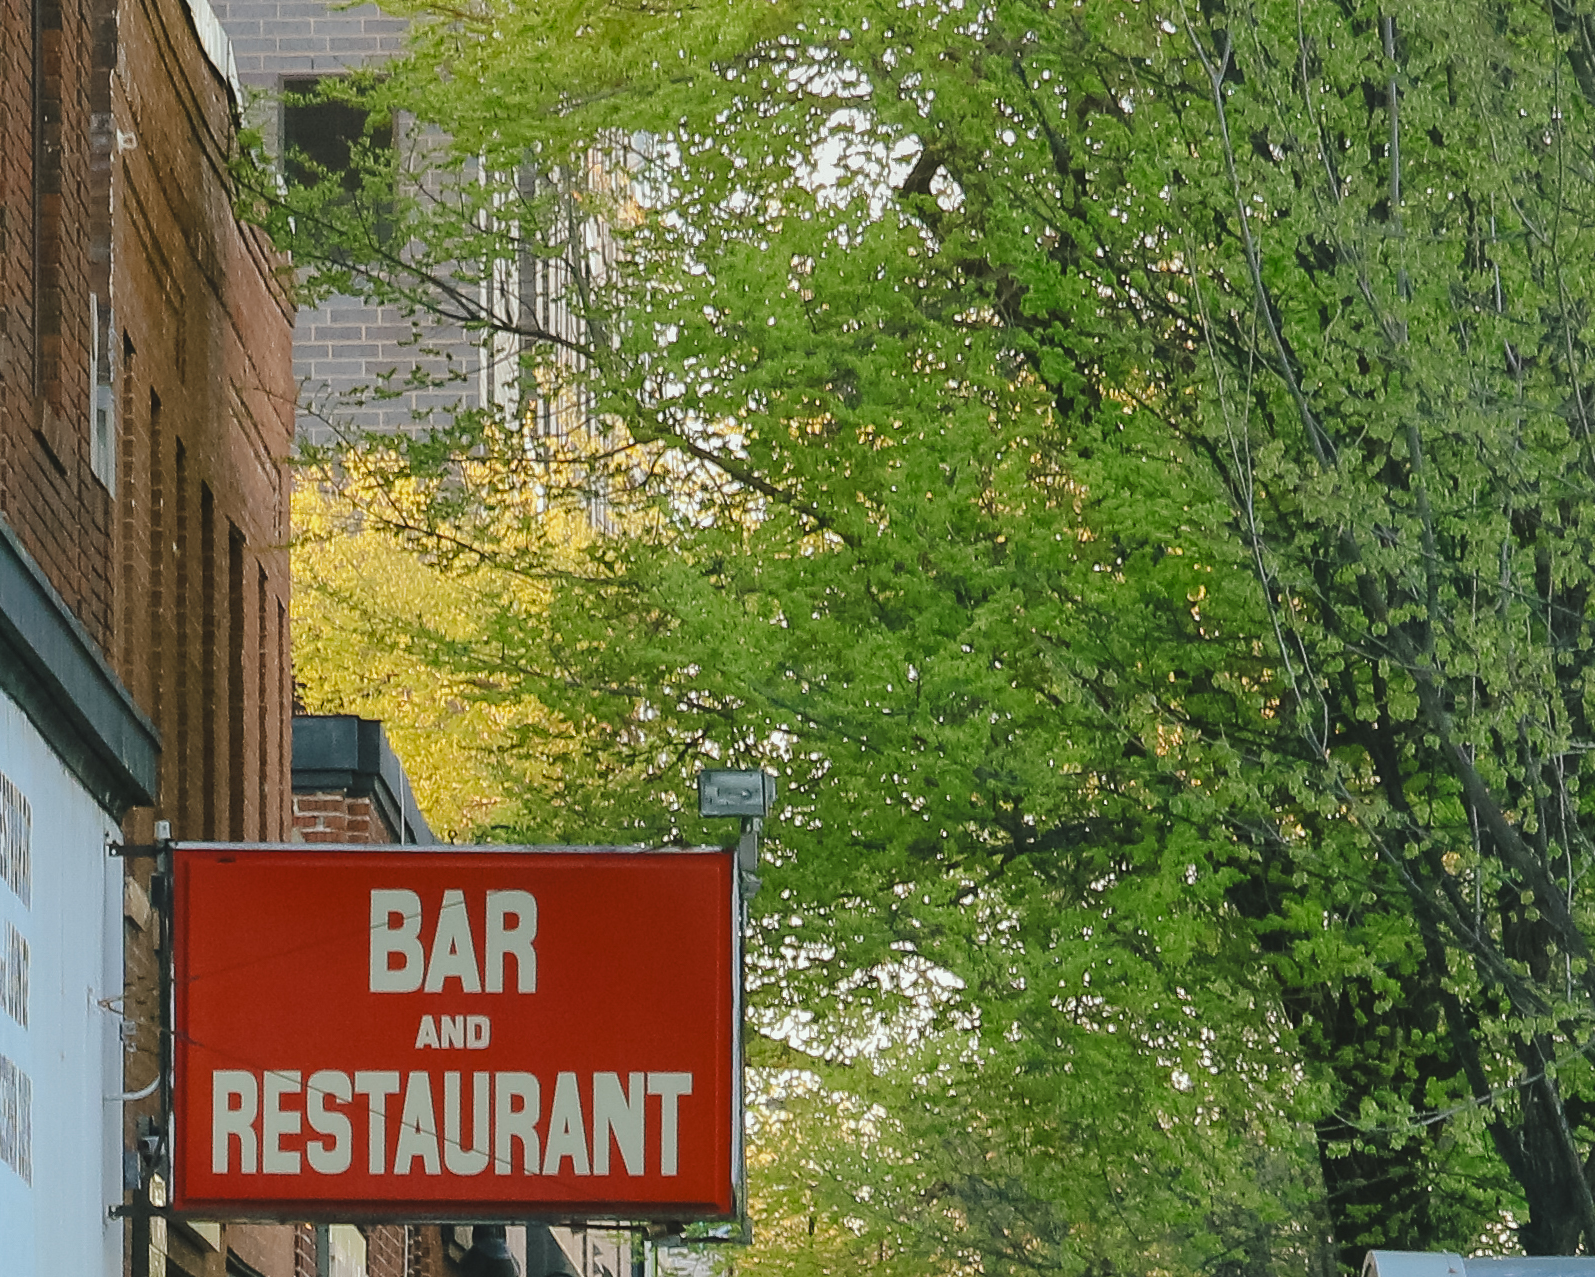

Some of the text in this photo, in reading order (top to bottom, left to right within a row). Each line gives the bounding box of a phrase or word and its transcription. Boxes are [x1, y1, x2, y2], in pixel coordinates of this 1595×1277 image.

[368, 888, 538, 994] BAR
[414, 1014, 492, 1050] AND
[211, 1068, 693, 1176] RESTAURANT
